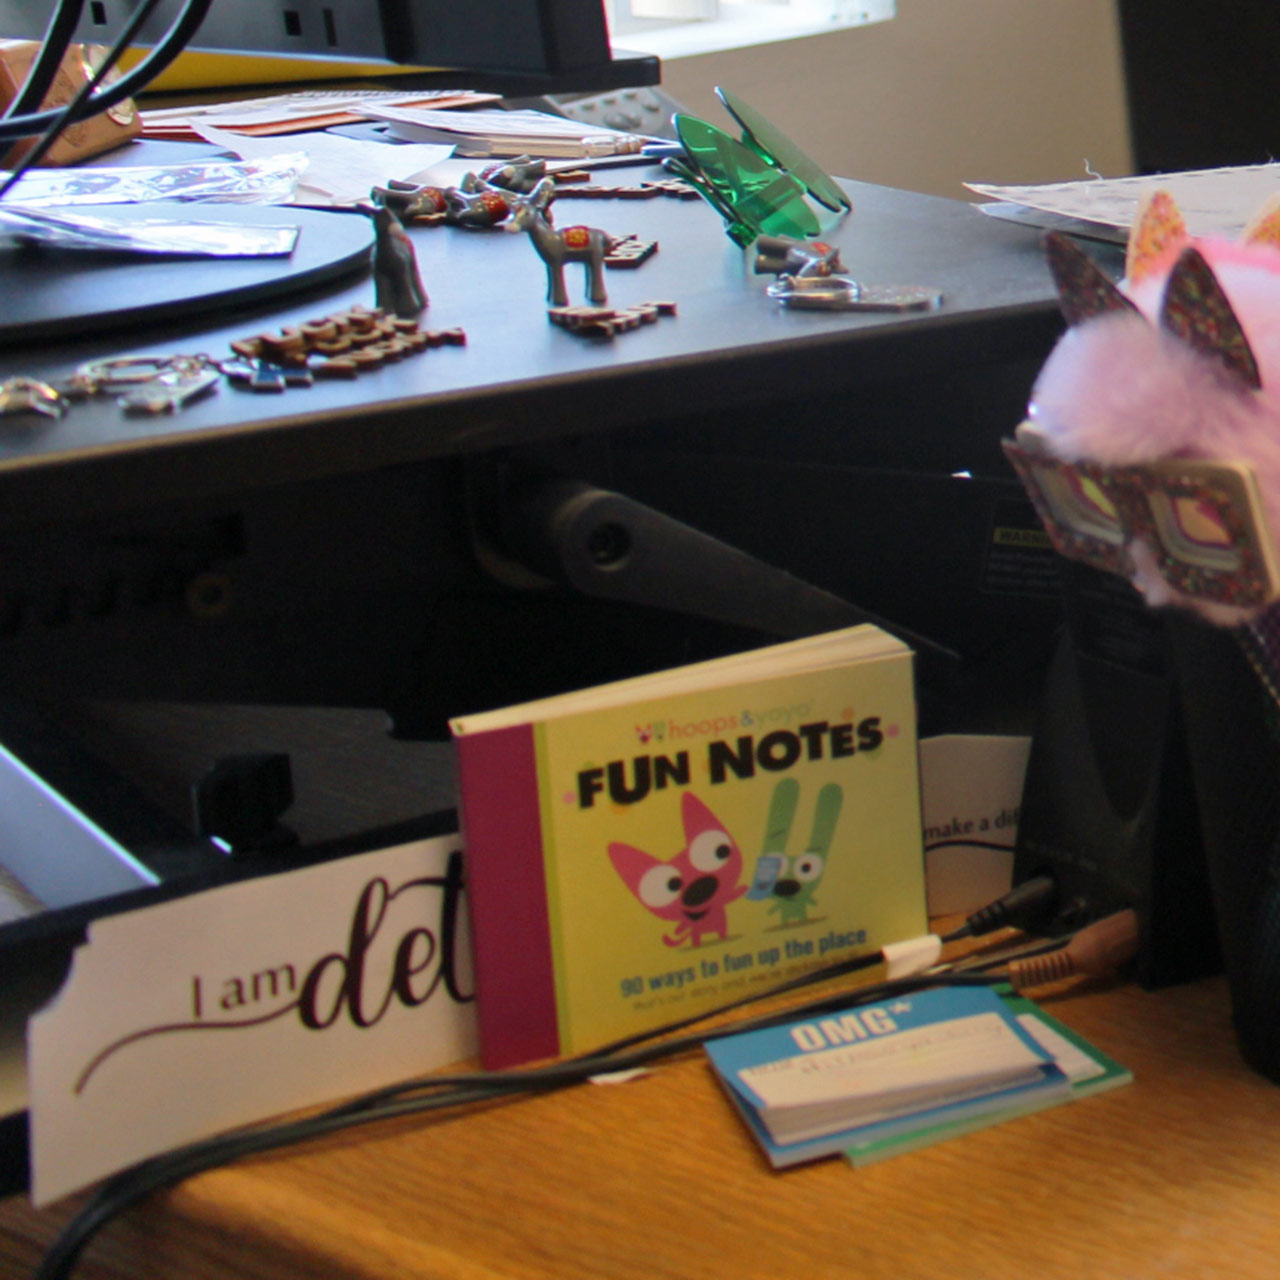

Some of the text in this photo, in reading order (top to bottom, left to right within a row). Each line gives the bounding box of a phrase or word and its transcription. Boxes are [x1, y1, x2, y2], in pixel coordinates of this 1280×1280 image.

[577, 717, 883, 809] FUN NOTES
[219, 963, 296, 1011] am
[299, 849, 476, 1031] det
[649, 965, 695, 991] ways
[701, 958, 718, 978] to
[724, 950, 753, 972] fun
[758, 945, 780, 967] up
[785, 937, 814, 958] the
[820, 928, 867, 955] place
